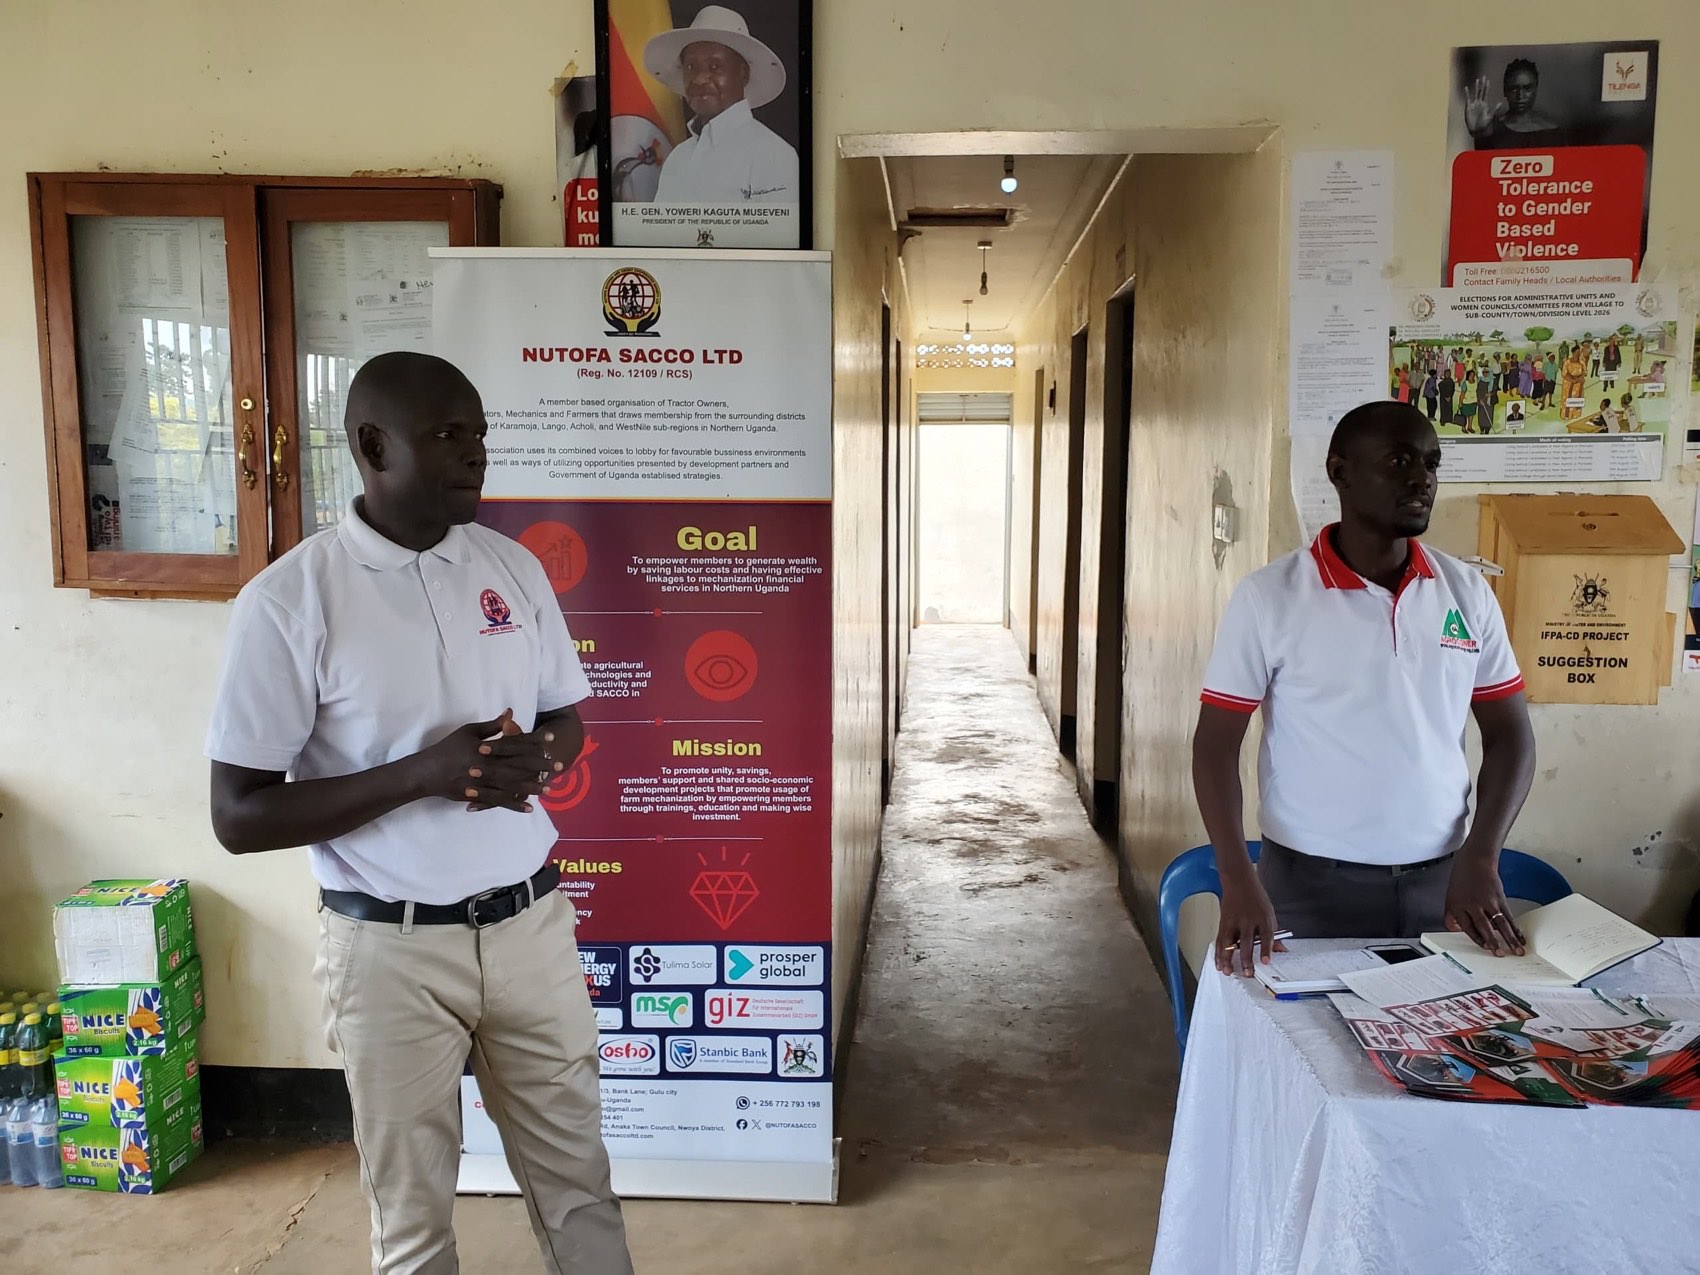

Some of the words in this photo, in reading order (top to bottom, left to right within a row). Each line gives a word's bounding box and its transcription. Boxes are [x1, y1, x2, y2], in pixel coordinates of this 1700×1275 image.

[1608, 82, 1640, 90] TILENGA
[1499, 158, 1543, 174] Zero
[1498, 176, 1593, 196] Tolerance
[641, 207, 663, 215] GEN.
[703, 208, 741, 216] KAGUTA
[742, 208, 789, 216] MUSEVENI
[1497, 201, 1516, 216] to
[1522, 198, 1592, 216] Gender
[1496, 219, 1555, 237] Based
[1495, 239, 1578, 259] Violence
[1464, 266, 1478, 276] Toll
[1463, 278, 1494, 286] Contact
[1495, 276, 1521, 287] Family
[1522, 276, 1548, 286] Heads
[1555, 275, 1577, 284] Local
[1578, 274, 1621, 283] Authorities
[1465, 310, 1570, 319] SUB-COUNTY/TOWN/DIVISION
[522, 346, 612, 363] NUTOFA
[618, 348, 694, 364] SACCO
[702, 349, 742, 364] LTD
[576, 368, 604, 379] (Reg.
[607, 368, 624, 377] No.
[627, 368, 657, 378] 12109
[660, 369, 663, 377] /
[666, 369, 692, 380] RCS)
[580, 398, 605, 406] based
[607, 399, 655, 408] organisation
[667, 398, 694, 407] Tractor
[696, 399, 729, 408] Owners,
[499, 422, 539, 431] Karamoja,
[541, 422, 568, 432] Lango,
[569, 422, 596, 431] Acholi,
[598, 422, 613, 430] and
[652, 423, 699, 433] sub-regions
[745, 424, 778, 433] Uganda.
[677, 526, 756, 550] Goal
[631, 556, 643, 564] To
[645, 557, 688, 566] empower
[690, 556, 732, 564] members
[746, 557, 785, 566] generate
[787, 556, 817, 566] wealth
[626, 565, 638, 575] by
[640, 564, 671, 575] saving
[673, 565, 703, 573] labour
[705, 566, 730, 575] costs
[732, 564, 751, 575] and
[751, 565, 781, 575] having
[784, 565, 822, 573] effective
[661, 583, 699, 592] services
[712, 583, 752, 592] Northern
[754, 584, 789, 594] Uganda
[1540, 631, 1579, 640] IFPA-CD
[1582, 631, 1629, 640] PROJECT
[1538, 656, 1628, 668] SUGGESTION
[1567, 672, 1595, 683] BOX
[596, 688, 629, 697] SACCO
[672, 738, 761, 756] Mission
[673, 767, 709, 776] promote
[711, 766, 734, 776] unity,
[736, 766, 771, 776] savings,
[618, 776, 660, 784] members'
[662, 776, 696, 785] support
[715, 775, 744, 786] shared
[622, 784, 678, 794] development
[680, 785, 714, 795] projects
[735, 785, 770, 794] promote
[553, 858, 622, 873] Values
[662, 960, 689, 969] Tulima
[691, 960, 712, 968] Solar
[760, 952, 816, 966] prosper
[759, 964, 805, 979] global
[709, 991, 750, 1024] giz
[82, 1014, 125, 1028] NICE
[603, 1042, 650, 1061] osho
[699, 1046, 738, 1057] Stanbic
[741, 1047, 767, 1057] Bank
[74, 1081, 109, 1094] NICE
[167, 1107, 184, 1125] NICE
[80, 1147, 118, 1160] NICE
